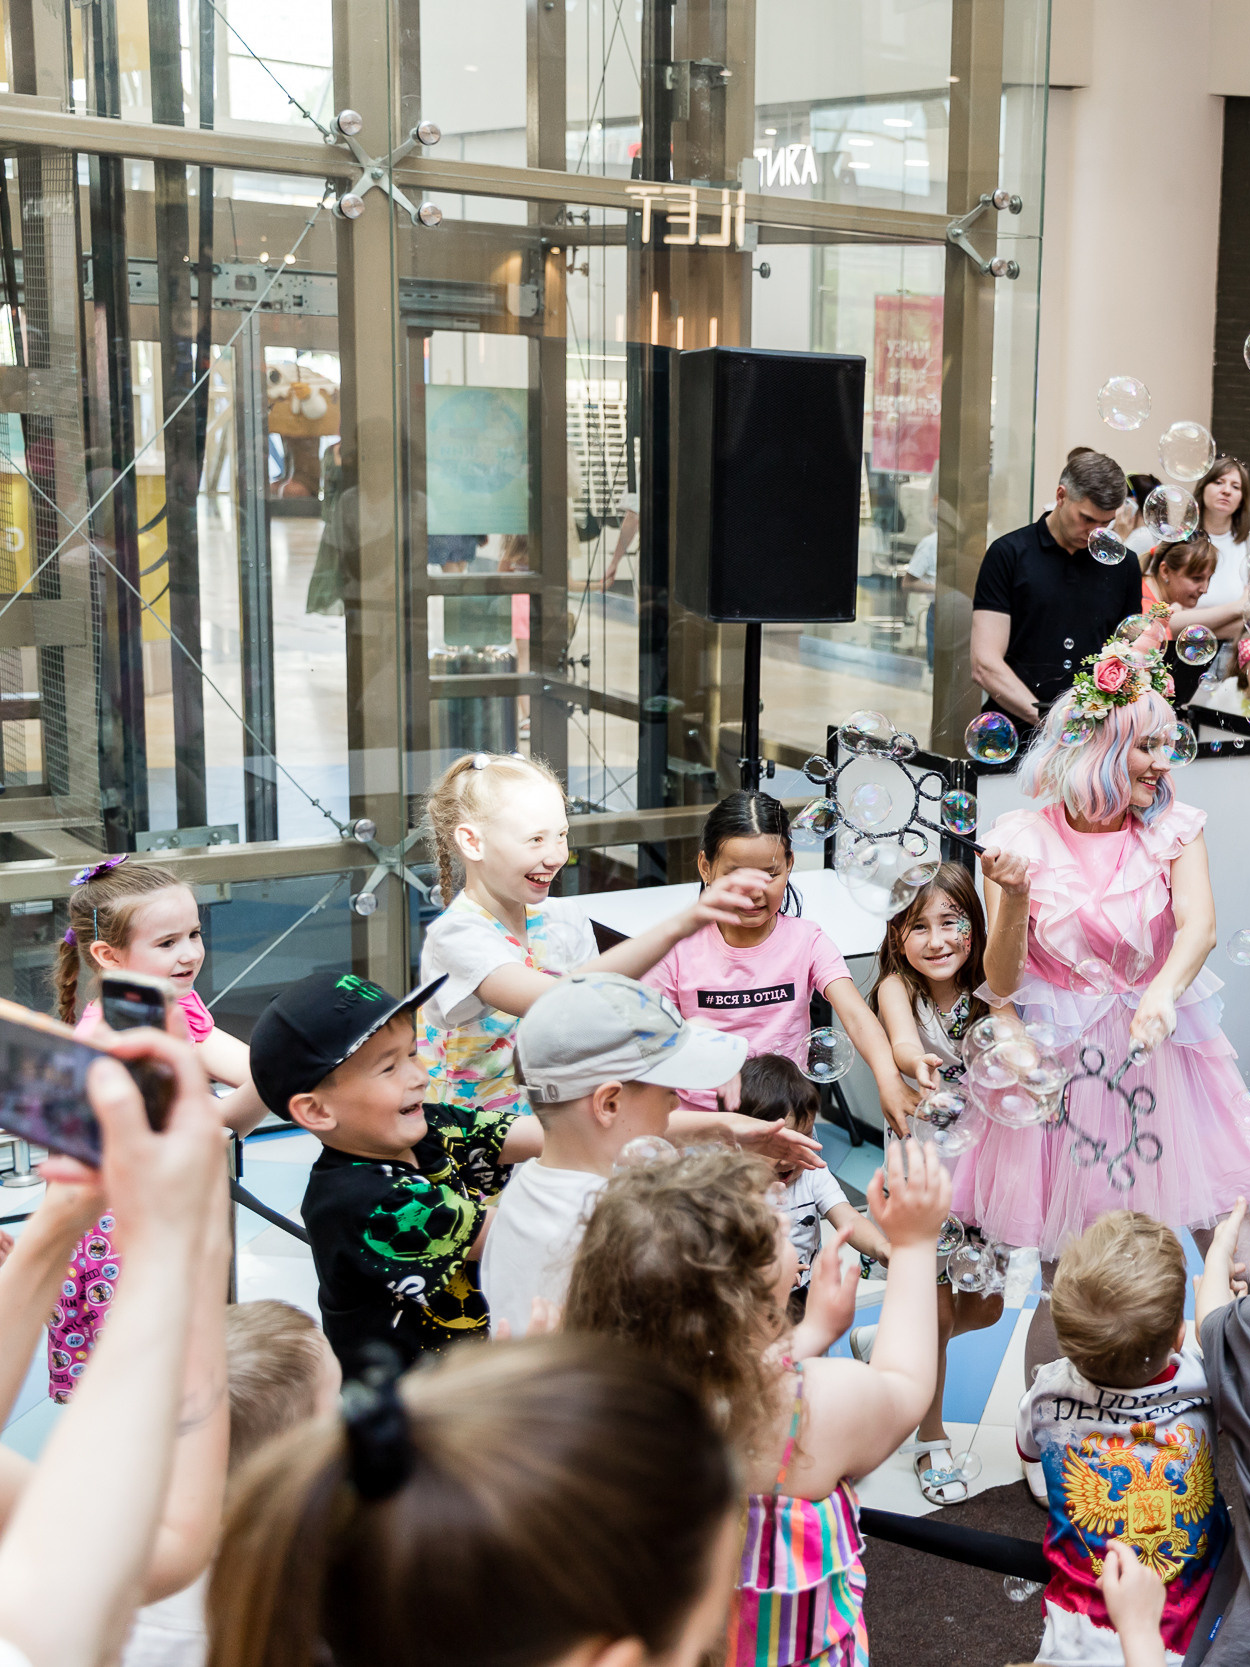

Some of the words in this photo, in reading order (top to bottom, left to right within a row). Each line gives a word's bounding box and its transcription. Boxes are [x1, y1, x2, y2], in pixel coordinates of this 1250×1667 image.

[706, 995, 740, 1005] #ВСЯ
[743, 994, 752, 1004] В
[754, 988, 788, 1002] ОТЦА
